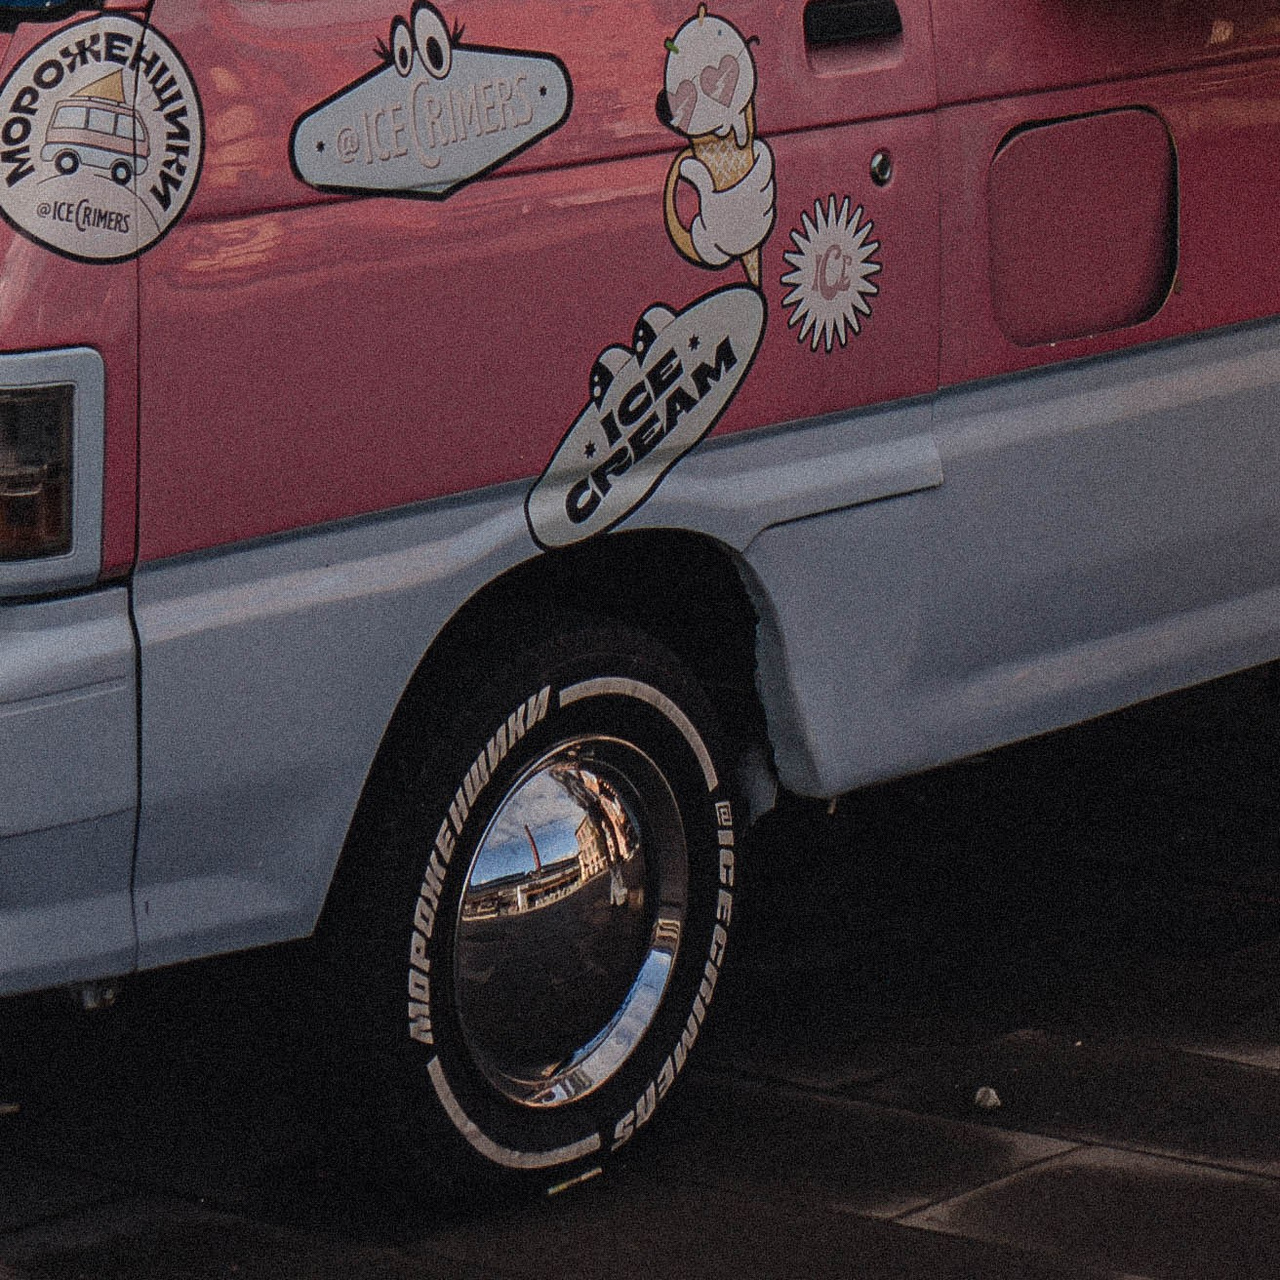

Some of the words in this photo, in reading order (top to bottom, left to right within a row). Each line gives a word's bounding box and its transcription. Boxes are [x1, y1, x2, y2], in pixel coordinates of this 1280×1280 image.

[1, 32, 191, 212] МОРОЖЕНЩИКИ
[337, 76, 535, 169] @ICECRIMERS
[36, 198, 131, 234] @ICECRIMERS
[810, 244, 853, 301] ICE
[565, 335, 738, 525] CREAM
[600, 345, 684, 443] ICE
[407, 685, 552, 1044] МОРОЖЕНЩИКИ
